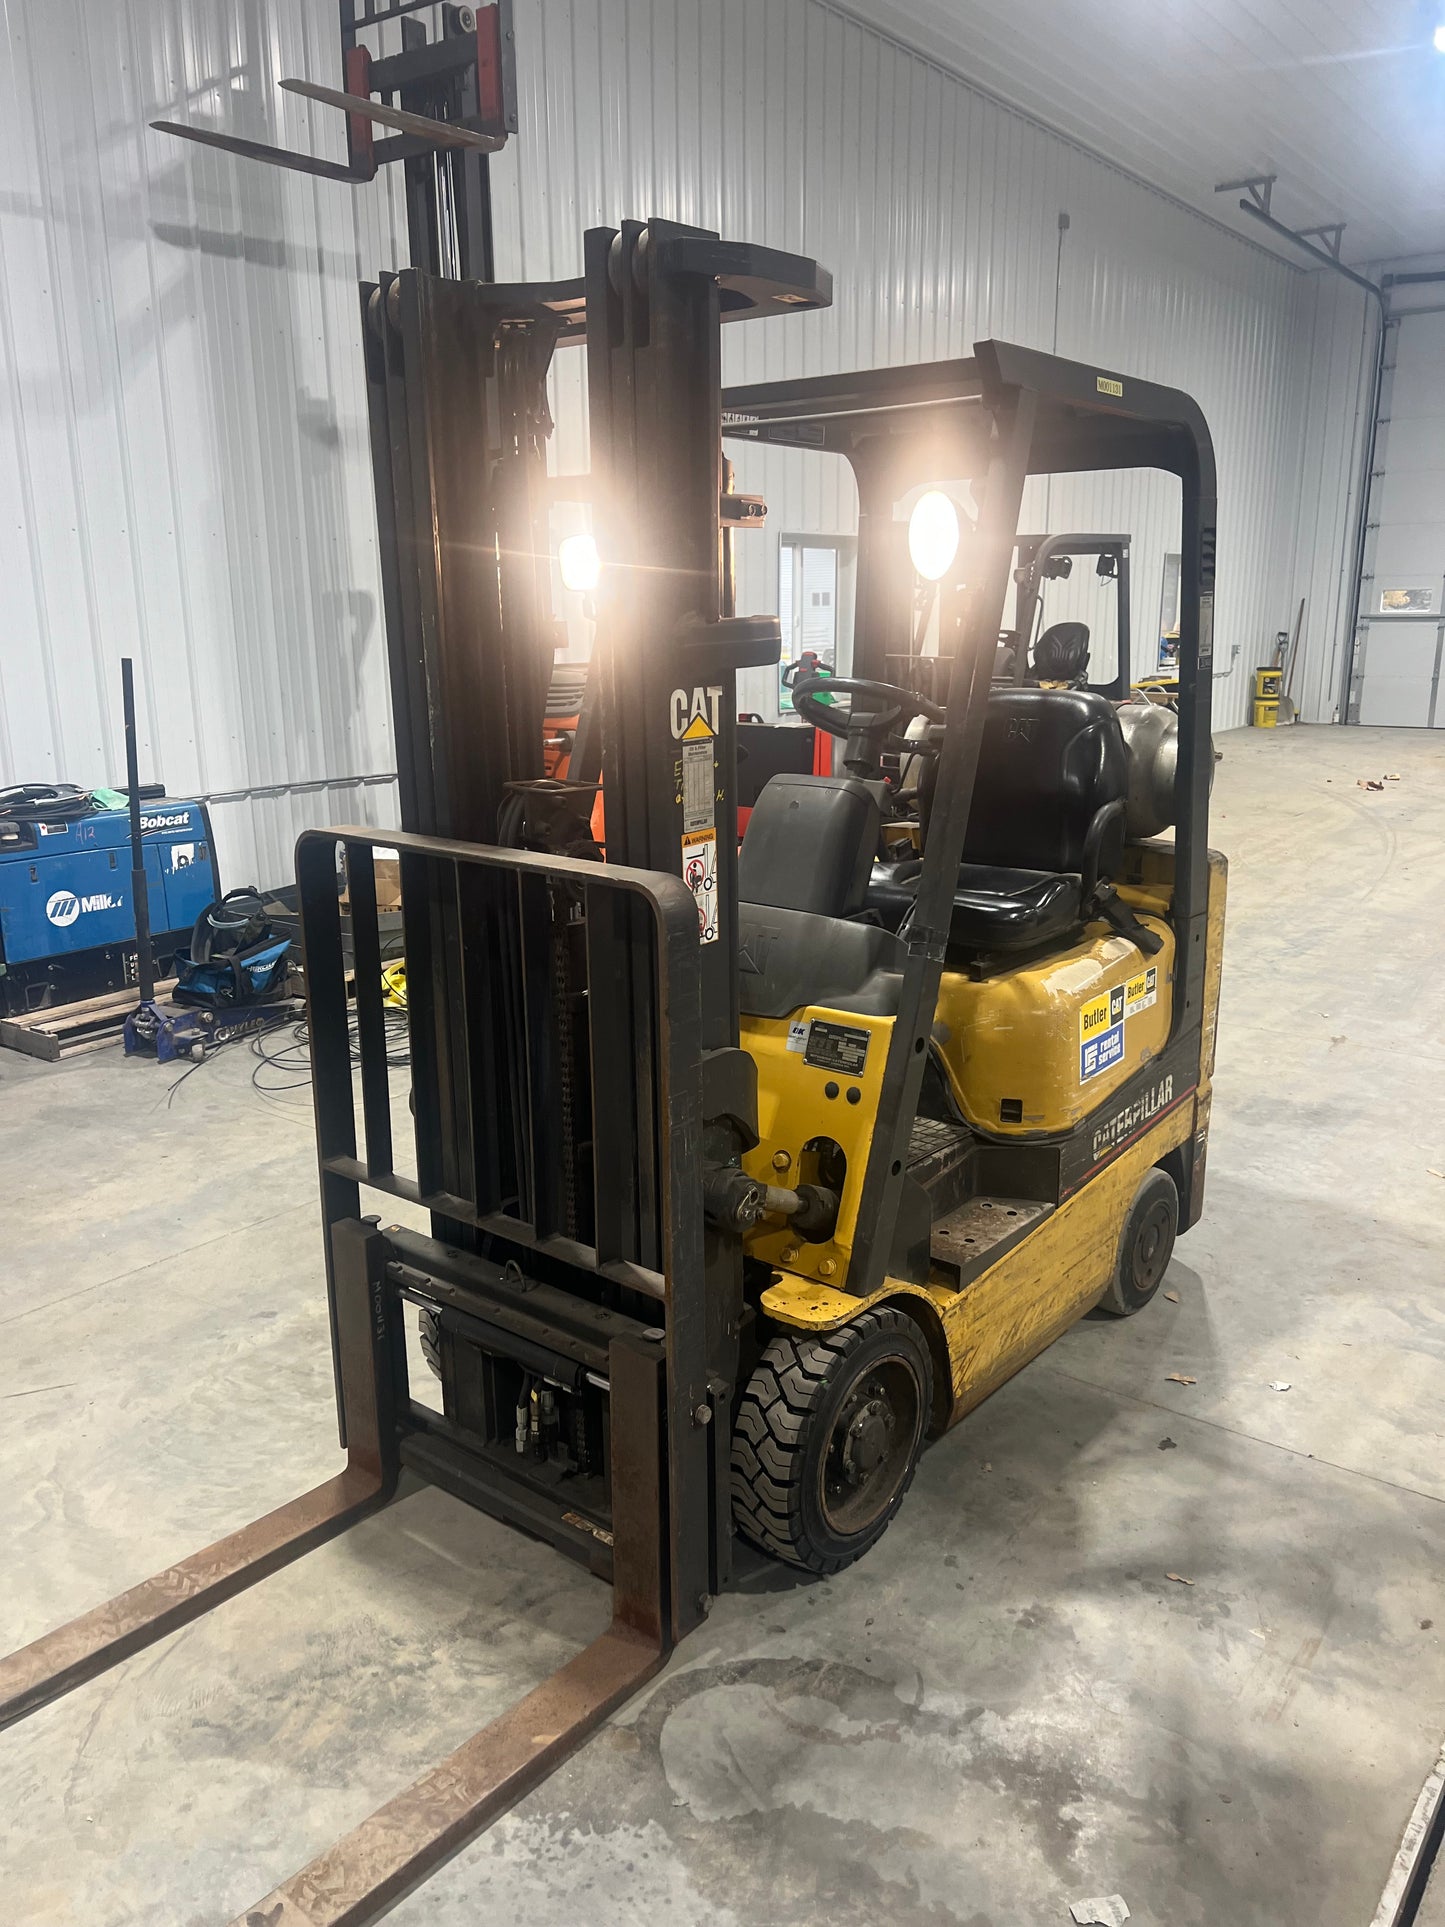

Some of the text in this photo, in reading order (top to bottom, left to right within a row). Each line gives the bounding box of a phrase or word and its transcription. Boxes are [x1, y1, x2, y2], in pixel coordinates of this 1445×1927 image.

[670, 686, 723, 739] CAT
[140, 811, 190, 829] Bobcat
[692, 833, 714, 843] WARNING
[1128, 982, 1145, 998] Butler
[1083, 1007, 1107, 1030] Butler
[1112, 996, 1123, 1015] CAT
[1100, 1030, 1120, 1053] rental
[1098, 1043, 1121, 1065] service
[1093, 1074, 1173, 1160] CATERPILLAR
